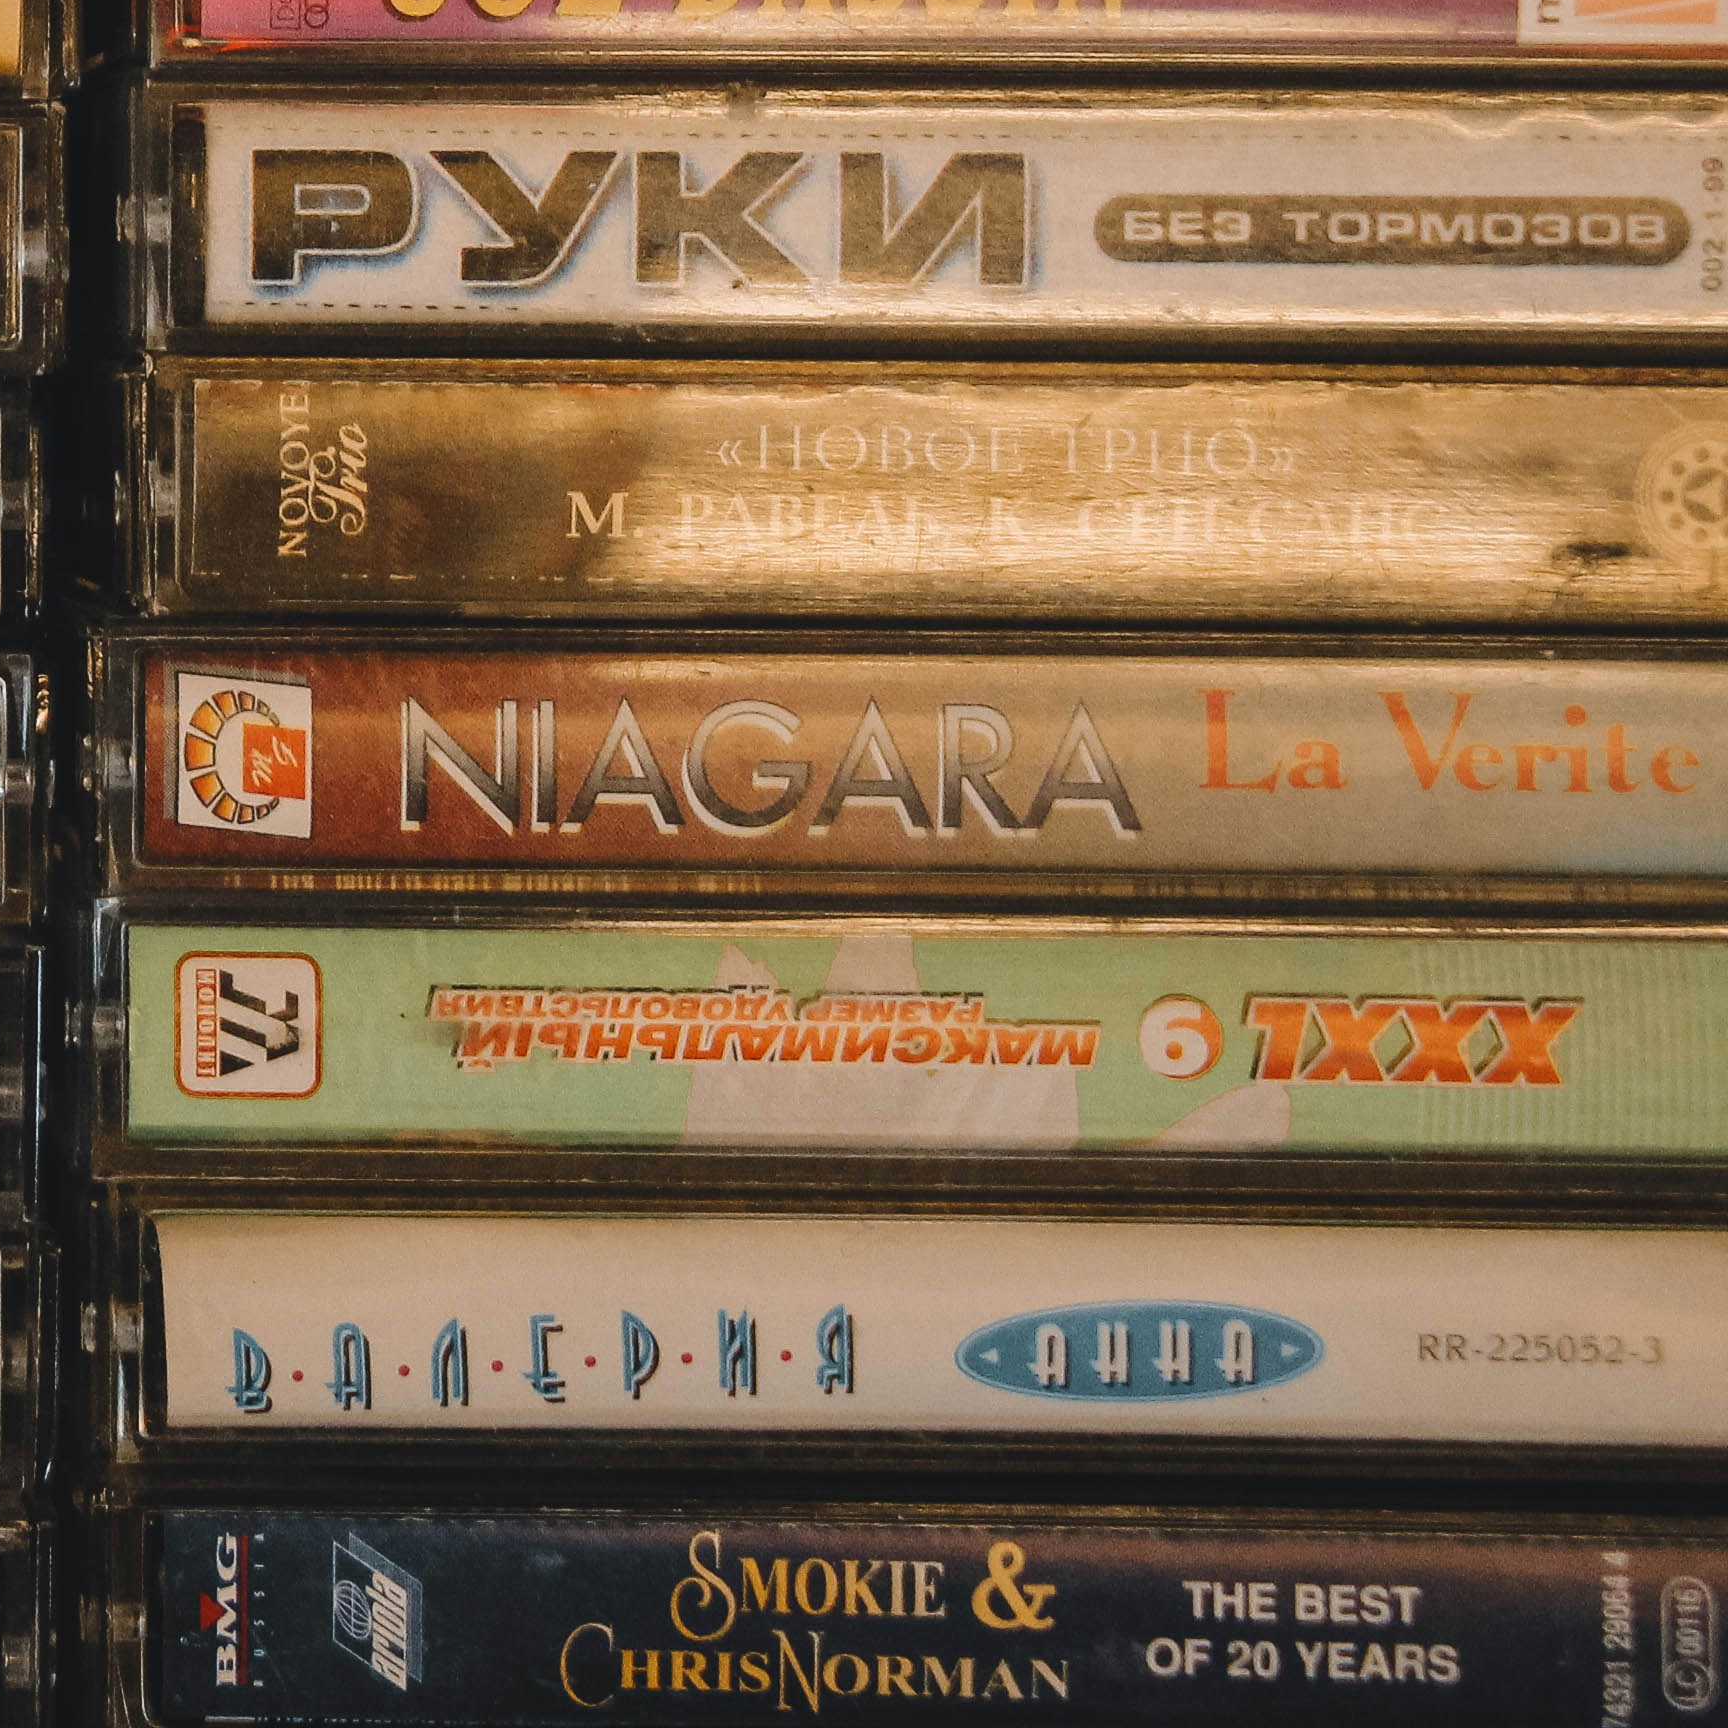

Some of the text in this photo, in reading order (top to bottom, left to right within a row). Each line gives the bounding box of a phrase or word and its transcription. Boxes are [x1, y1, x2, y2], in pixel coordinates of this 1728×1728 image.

[249, 148, 1668, 290] РУКИ БЕЗ ТОРМОЗОВ
[277, 393, 311, 557] NOVOYE
[400, 688, 1702, 838] NIAGARA La Verite
[196, 969, 217, 1078] МОНОЛИТ
[436, 990, 985, 1024] РАЗМЕР УДОВОЛЬСТВИЯ
[459, 1022, 1100, 1069] МАКСИМАЛЬНЫЙ
[1244, 994, 1582, 1086] XXXL
[1029, 1322, 1258, 1387] АННА
[1418, 1334, 1666, 1365] RR-225052-3
[217, 1533, 239, 1686] BMG
[371, 1568, 407, 1691] ariola
[670, 1530, 1056, 1644] SMOKIE &
[1183, 1580, 1421, 1625] THE BEST
[1146, 1637, 1459, 1682] OF 20 YEARS
